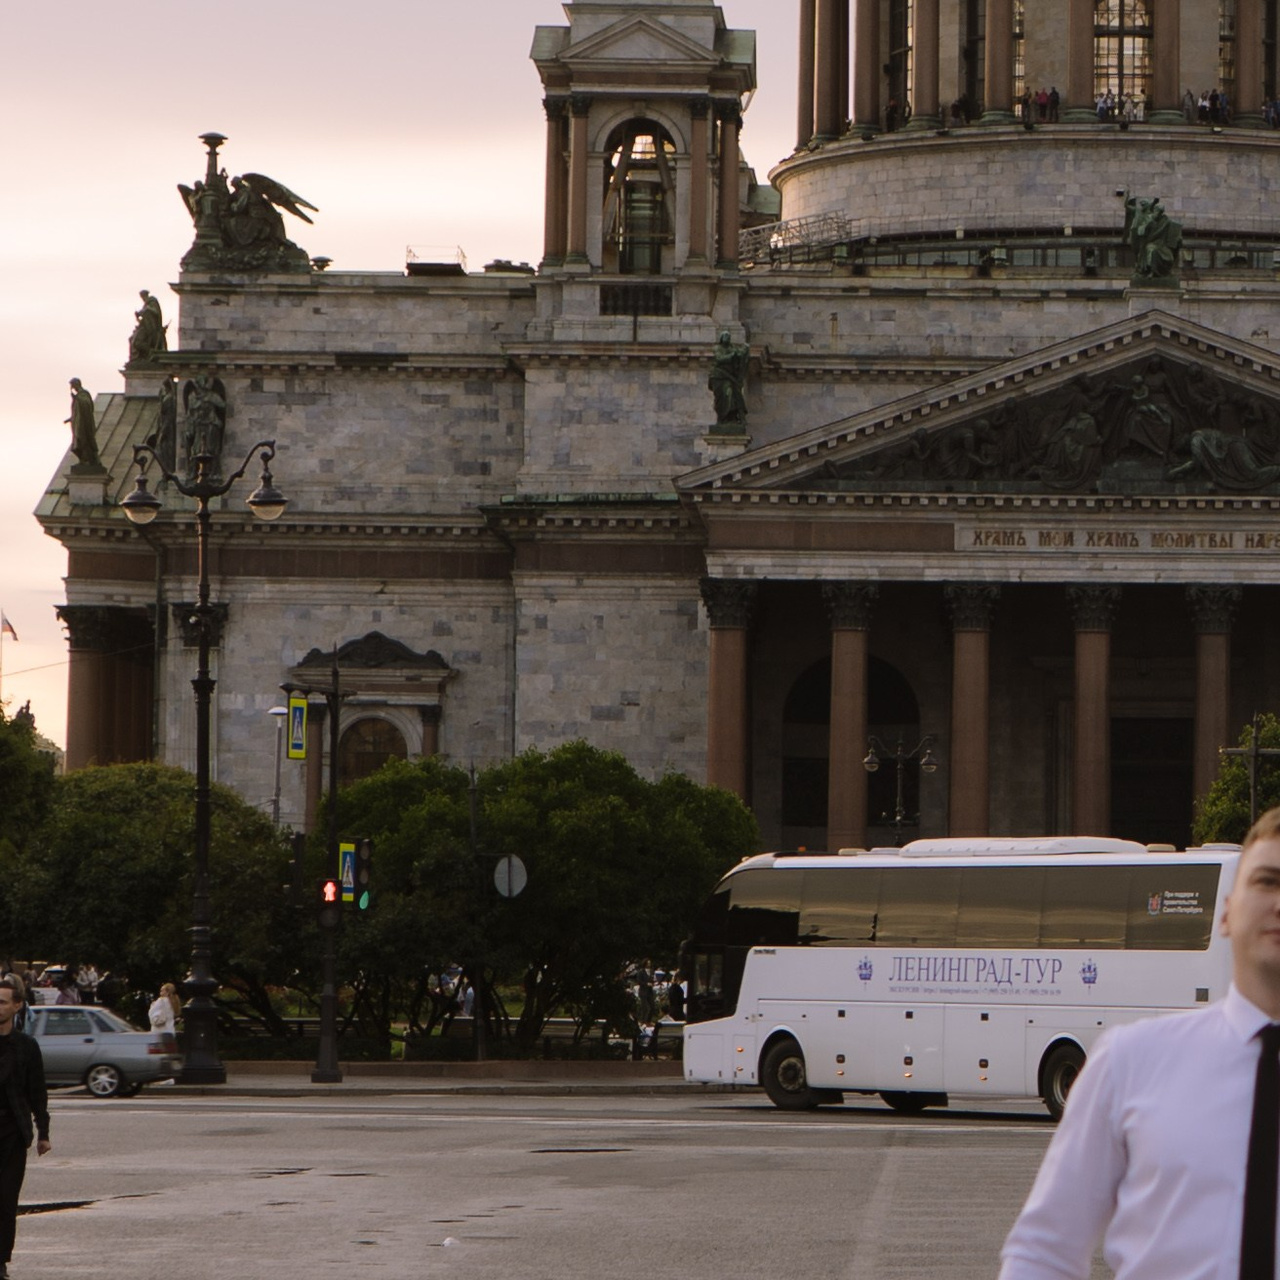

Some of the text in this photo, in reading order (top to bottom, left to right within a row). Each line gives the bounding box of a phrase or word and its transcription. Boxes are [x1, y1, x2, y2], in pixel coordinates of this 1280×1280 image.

[973, 530, 1027, 547] ХРАМЪ
[1085, 531, 1140, 547] ХРАМЪ
[888, 956, 1063, 986] ЛЕНИНГРАД-ТУР
